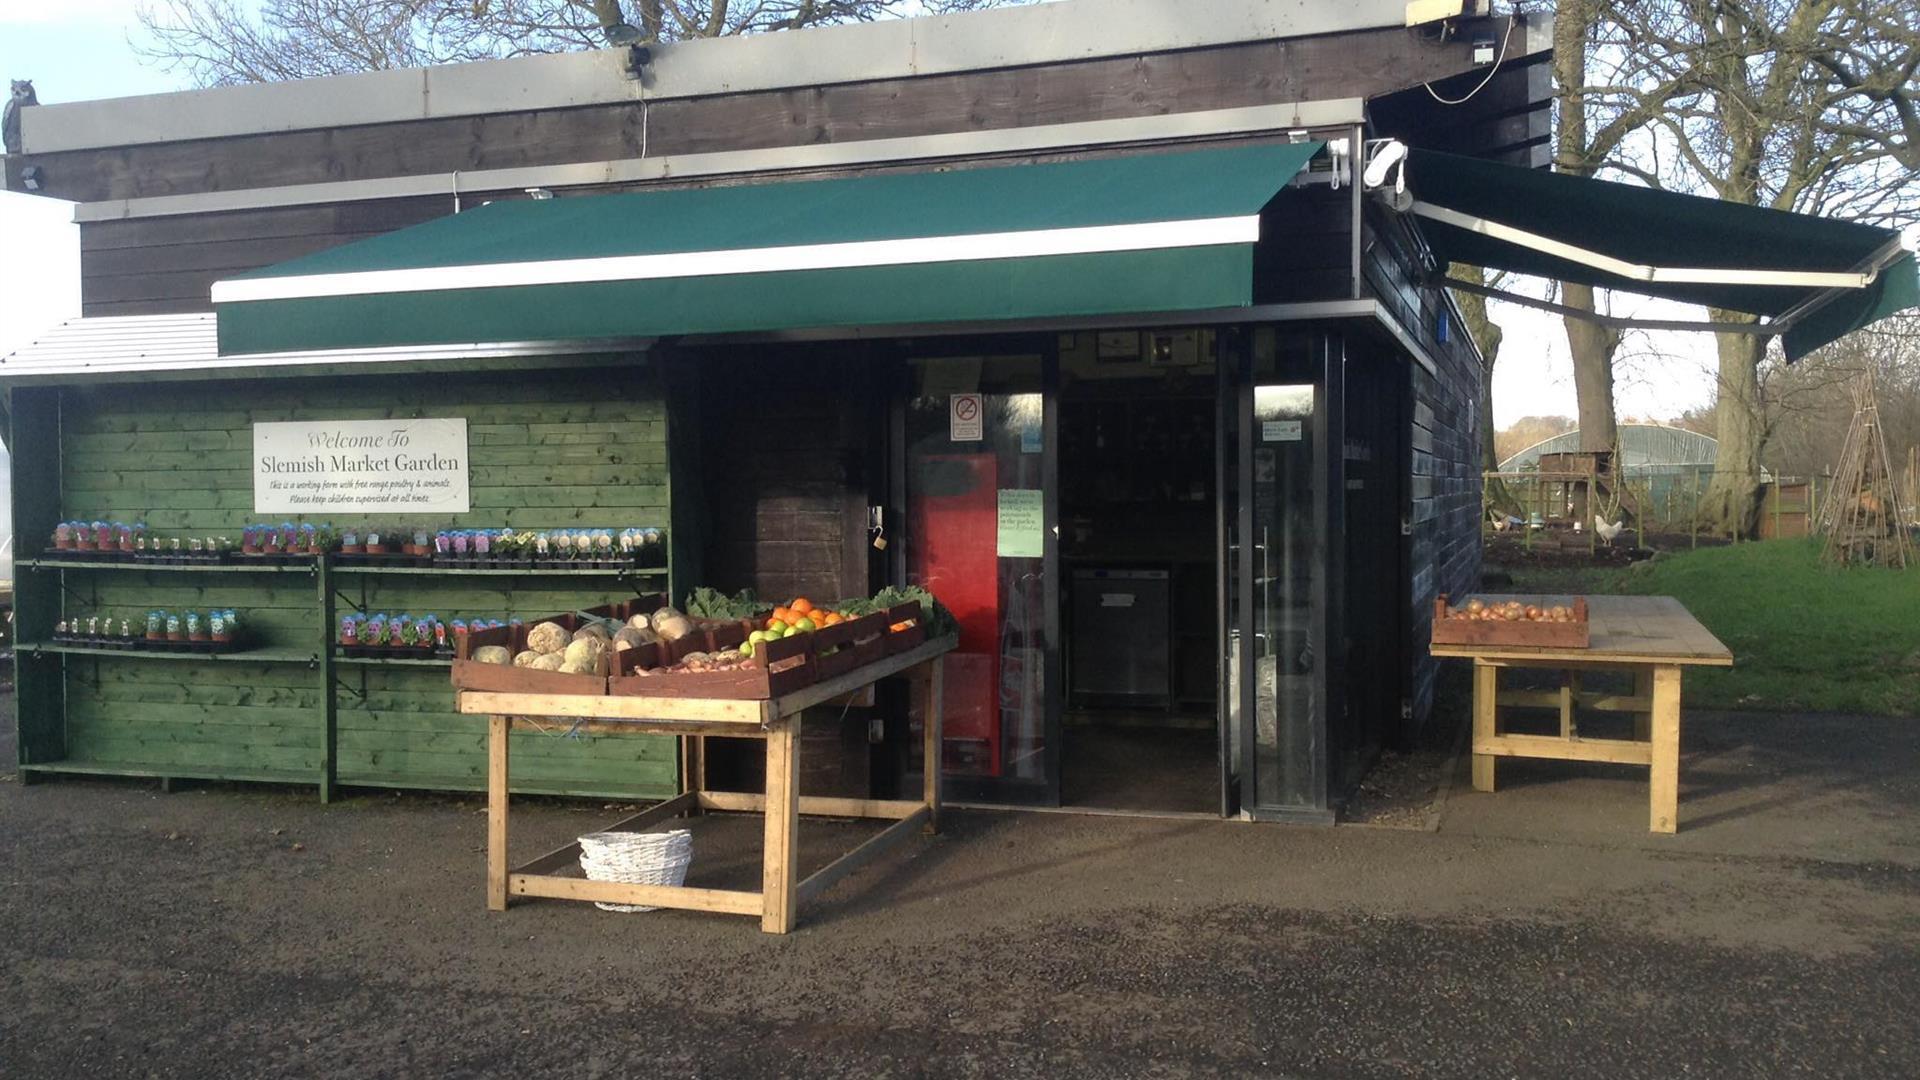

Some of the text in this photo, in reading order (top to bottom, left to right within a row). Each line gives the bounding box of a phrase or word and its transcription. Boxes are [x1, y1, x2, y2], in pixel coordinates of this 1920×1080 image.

[307, 428, 410, 448] Welcome To
[261, 452, 459, 473] Slemish Market Garden
[270, 480, 281, 489] This
[283, 480, 288, 489] is
[296, 480, 321, 492] working
[322, 480, 338, 490] farm
[339, 479, 354, 489] with
[354, 479, 368, 490] free
[368, 480, 389, 492] range
[389, 479, 414, 492] poultry
[415, 479, 421, 488] &
[423, 478, 450, 488] animals
[289, 494, 311, 504] Please
[312, 494, 327, 505] keep
[327, 493, 354, 503] children
[355, 493, 391, 505] supervised
[391, 494, 399, 502] at
[399, 493, 411, 503] all
